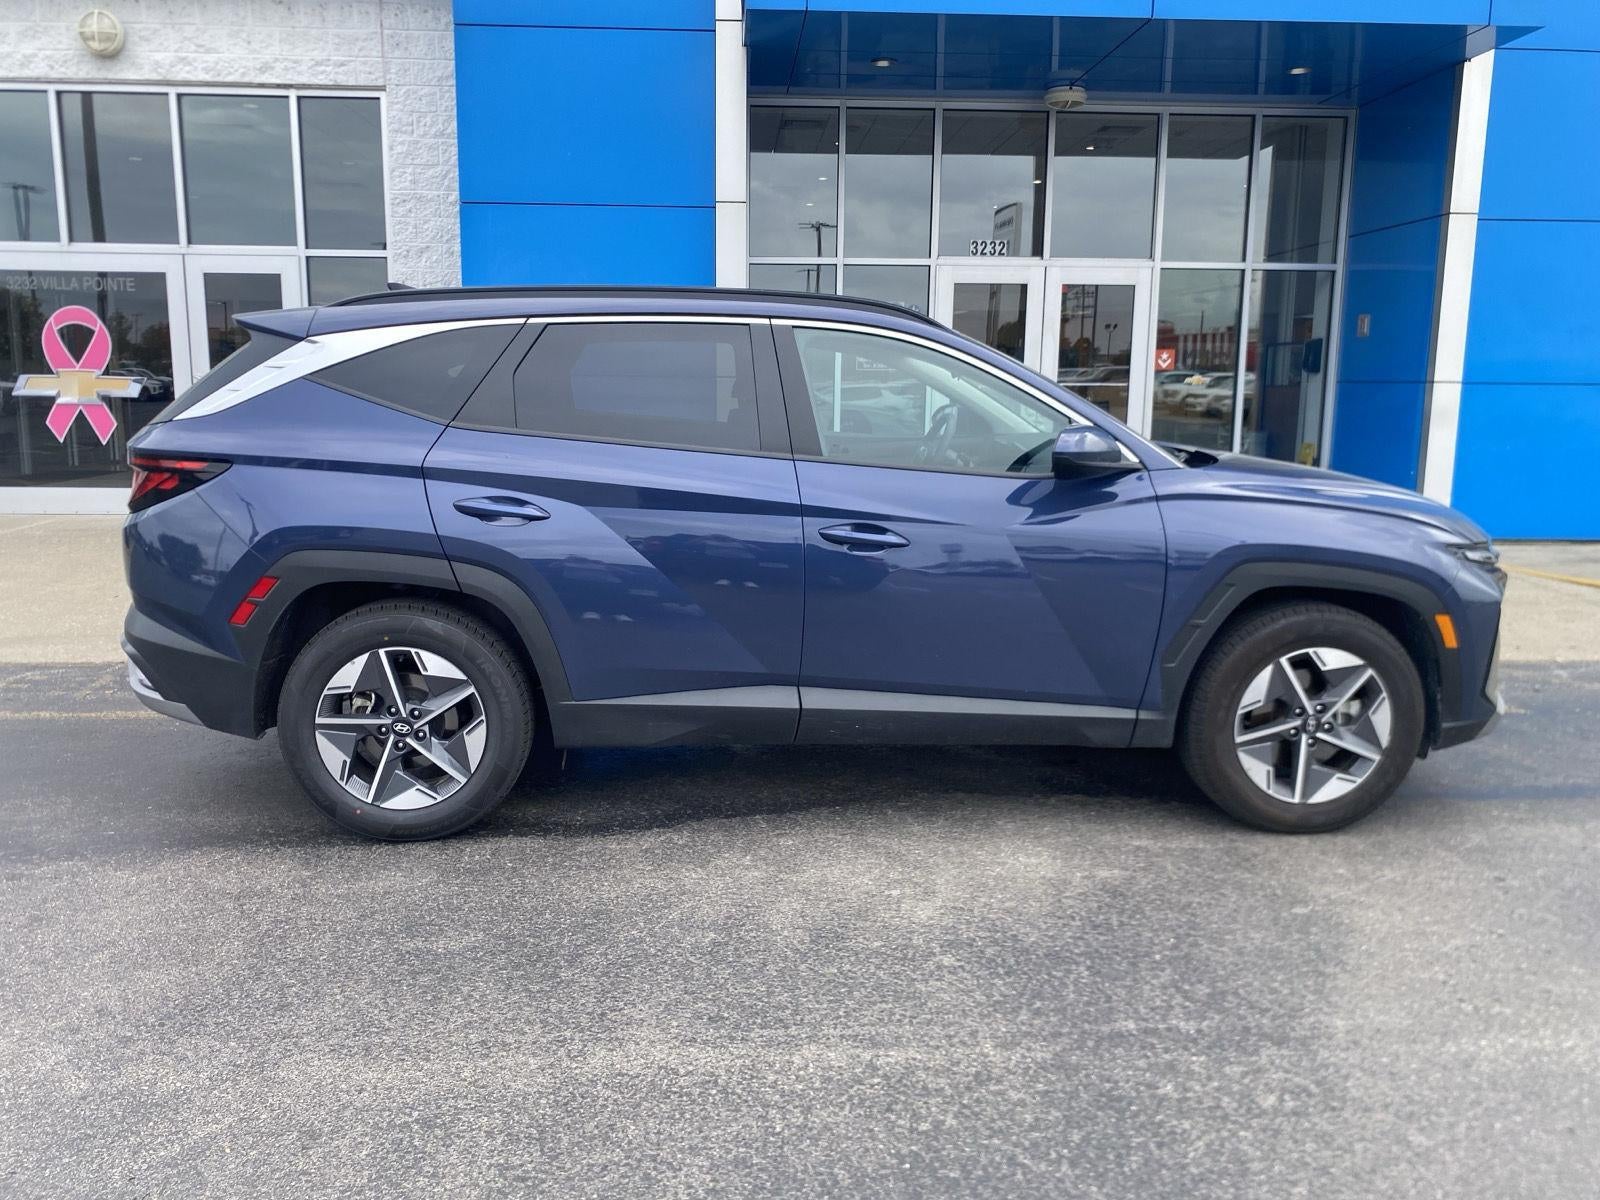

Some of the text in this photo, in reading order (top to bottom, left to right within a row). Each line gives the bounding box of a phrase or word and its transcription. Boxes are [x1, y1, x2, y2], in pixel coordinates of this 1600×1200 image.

[970, 240, 1007, 256] 3232
[6, 276, 136, 292] 3232 VILLA POINTE
